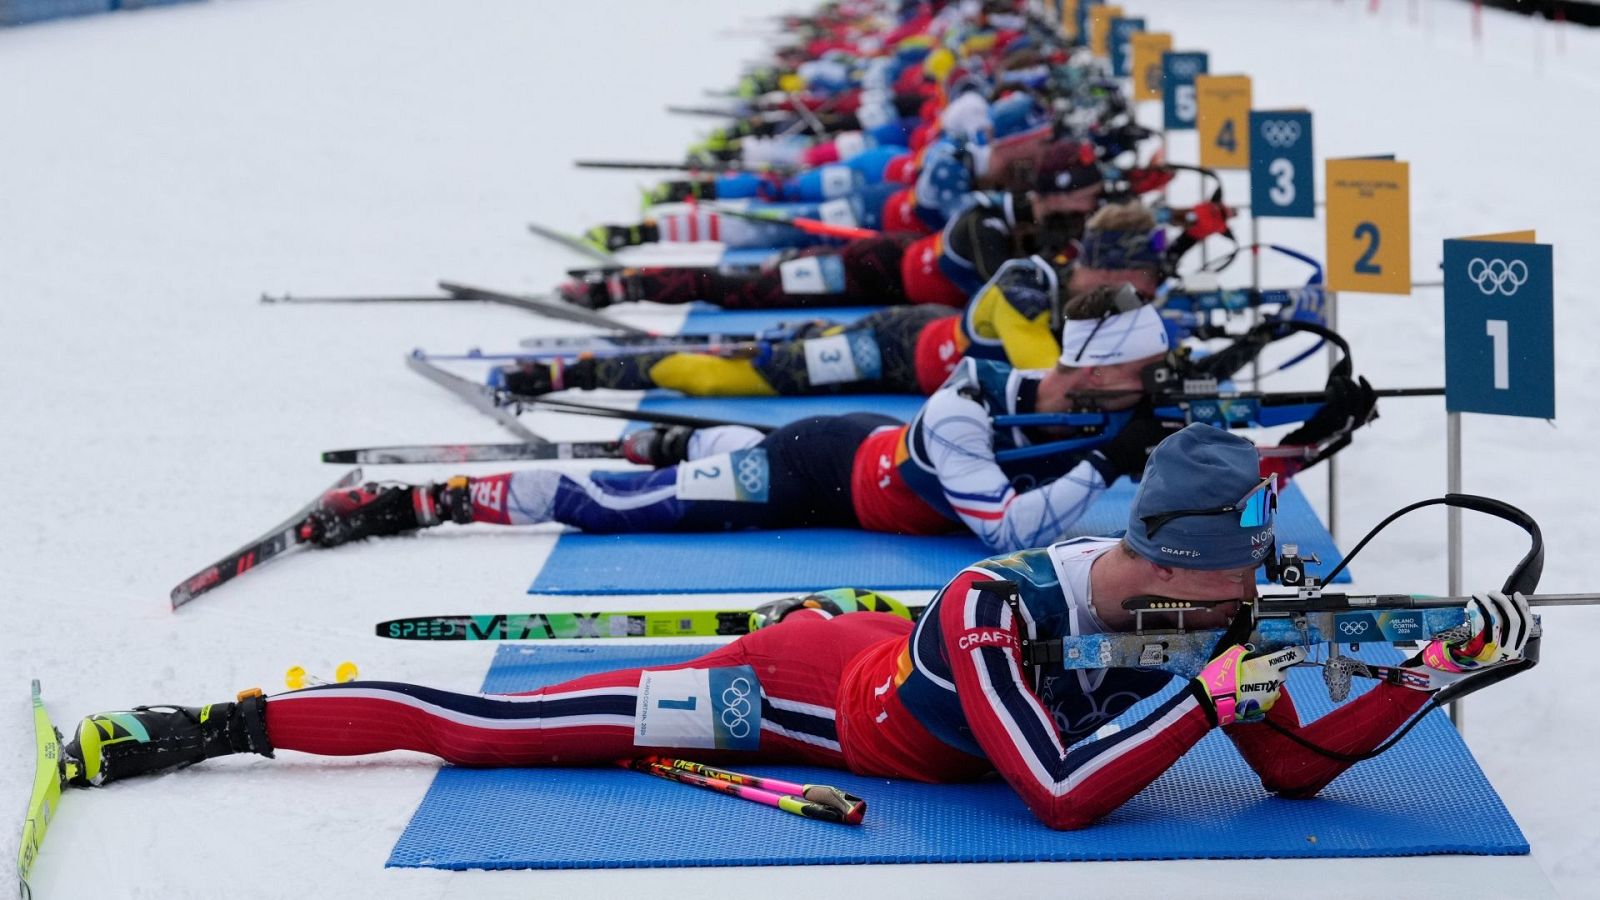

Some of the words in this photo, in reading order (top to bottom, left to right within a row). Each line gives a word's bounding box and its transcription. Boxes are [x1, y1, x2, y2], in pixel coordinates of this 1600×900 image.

[1175, 85, 1197, 122] 5
[1215, 119, 1238, 153] 4
[1269, 158, 1296, 206] 3
[1353, 221, 1382, 275] 2
[820, 350, 842, 363] 3
[1486, 319, 1509, 390] 1
[694, 467, 721, 479] 2
[1161, 546, 1191, 557] CRAFT
[959, 631, 1013, 650] CRAFT
[658, 696, 696, 711] 1
